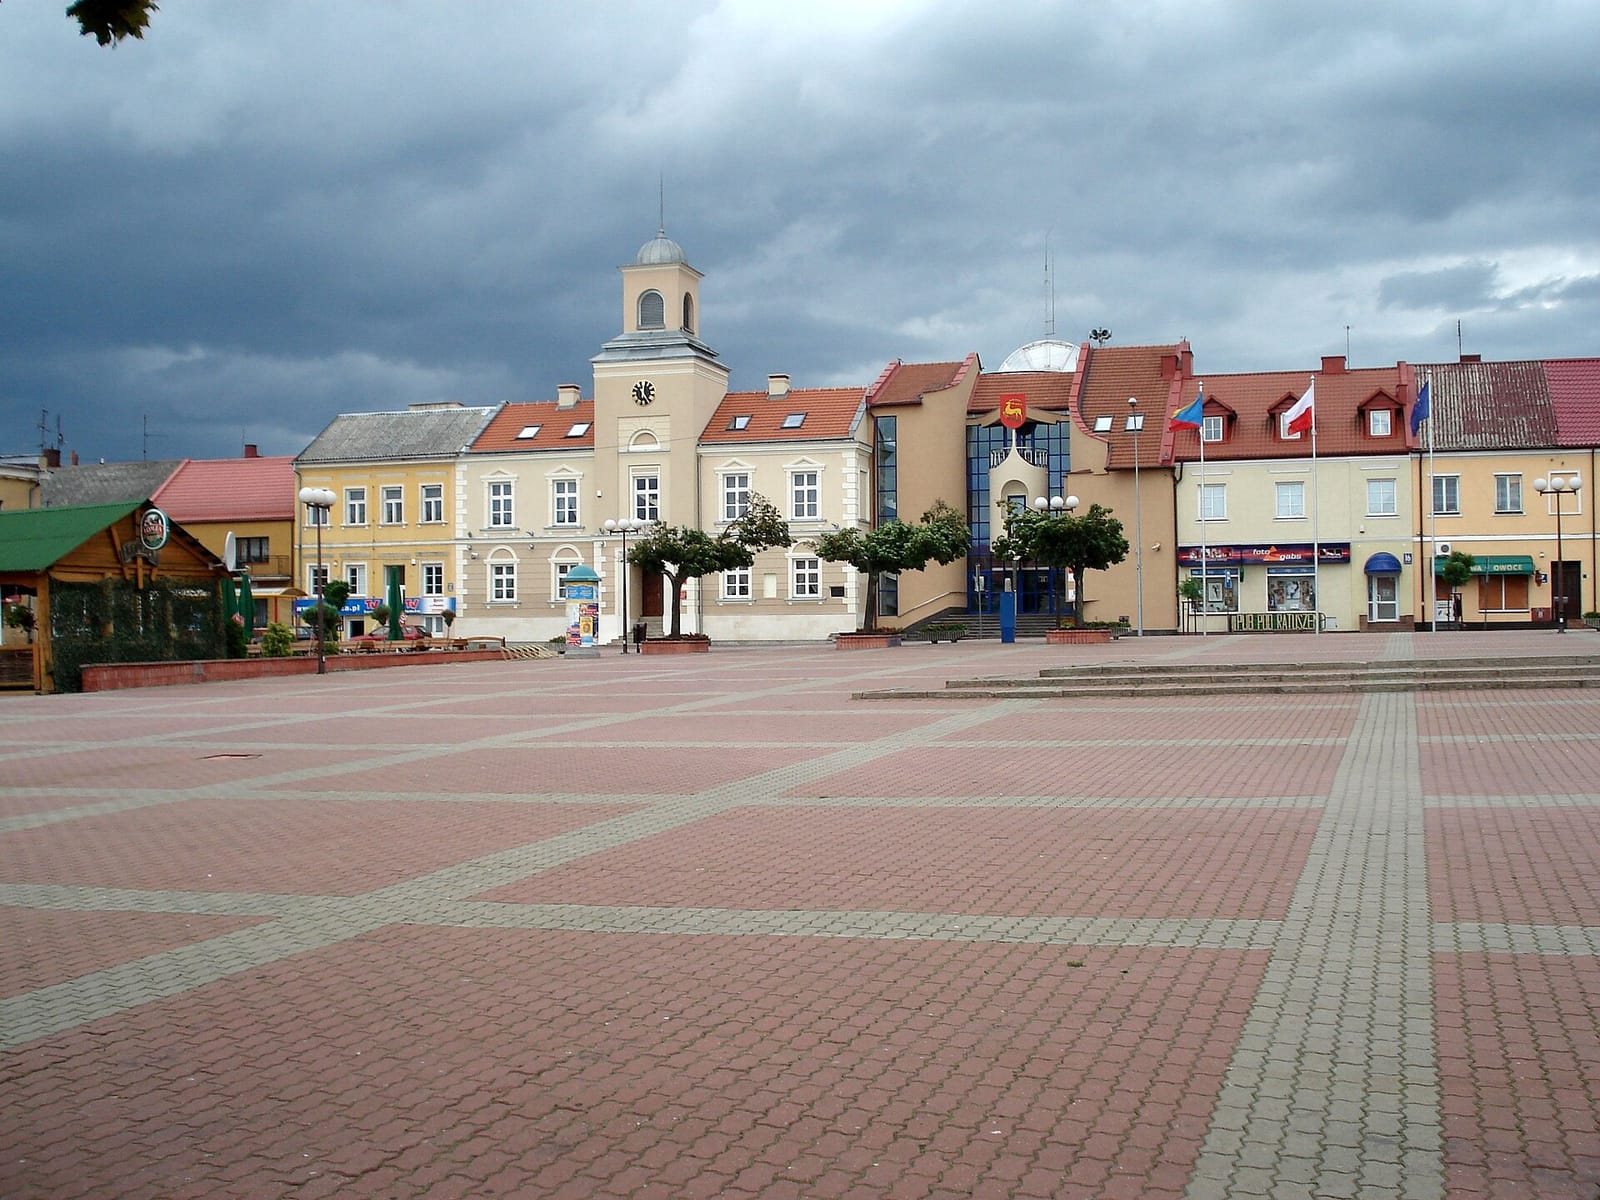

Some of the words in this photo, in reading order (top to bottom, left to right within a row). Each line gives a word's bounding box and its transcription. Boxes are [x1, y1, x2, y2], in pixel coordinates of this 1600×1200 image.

[1279, 553, 1302, 561] gabs
[1237, 614, 1254, 631] PUB
[1257, 614, 1273, 631] POD
[1276, 614, 1320, 631] RATUSZE
